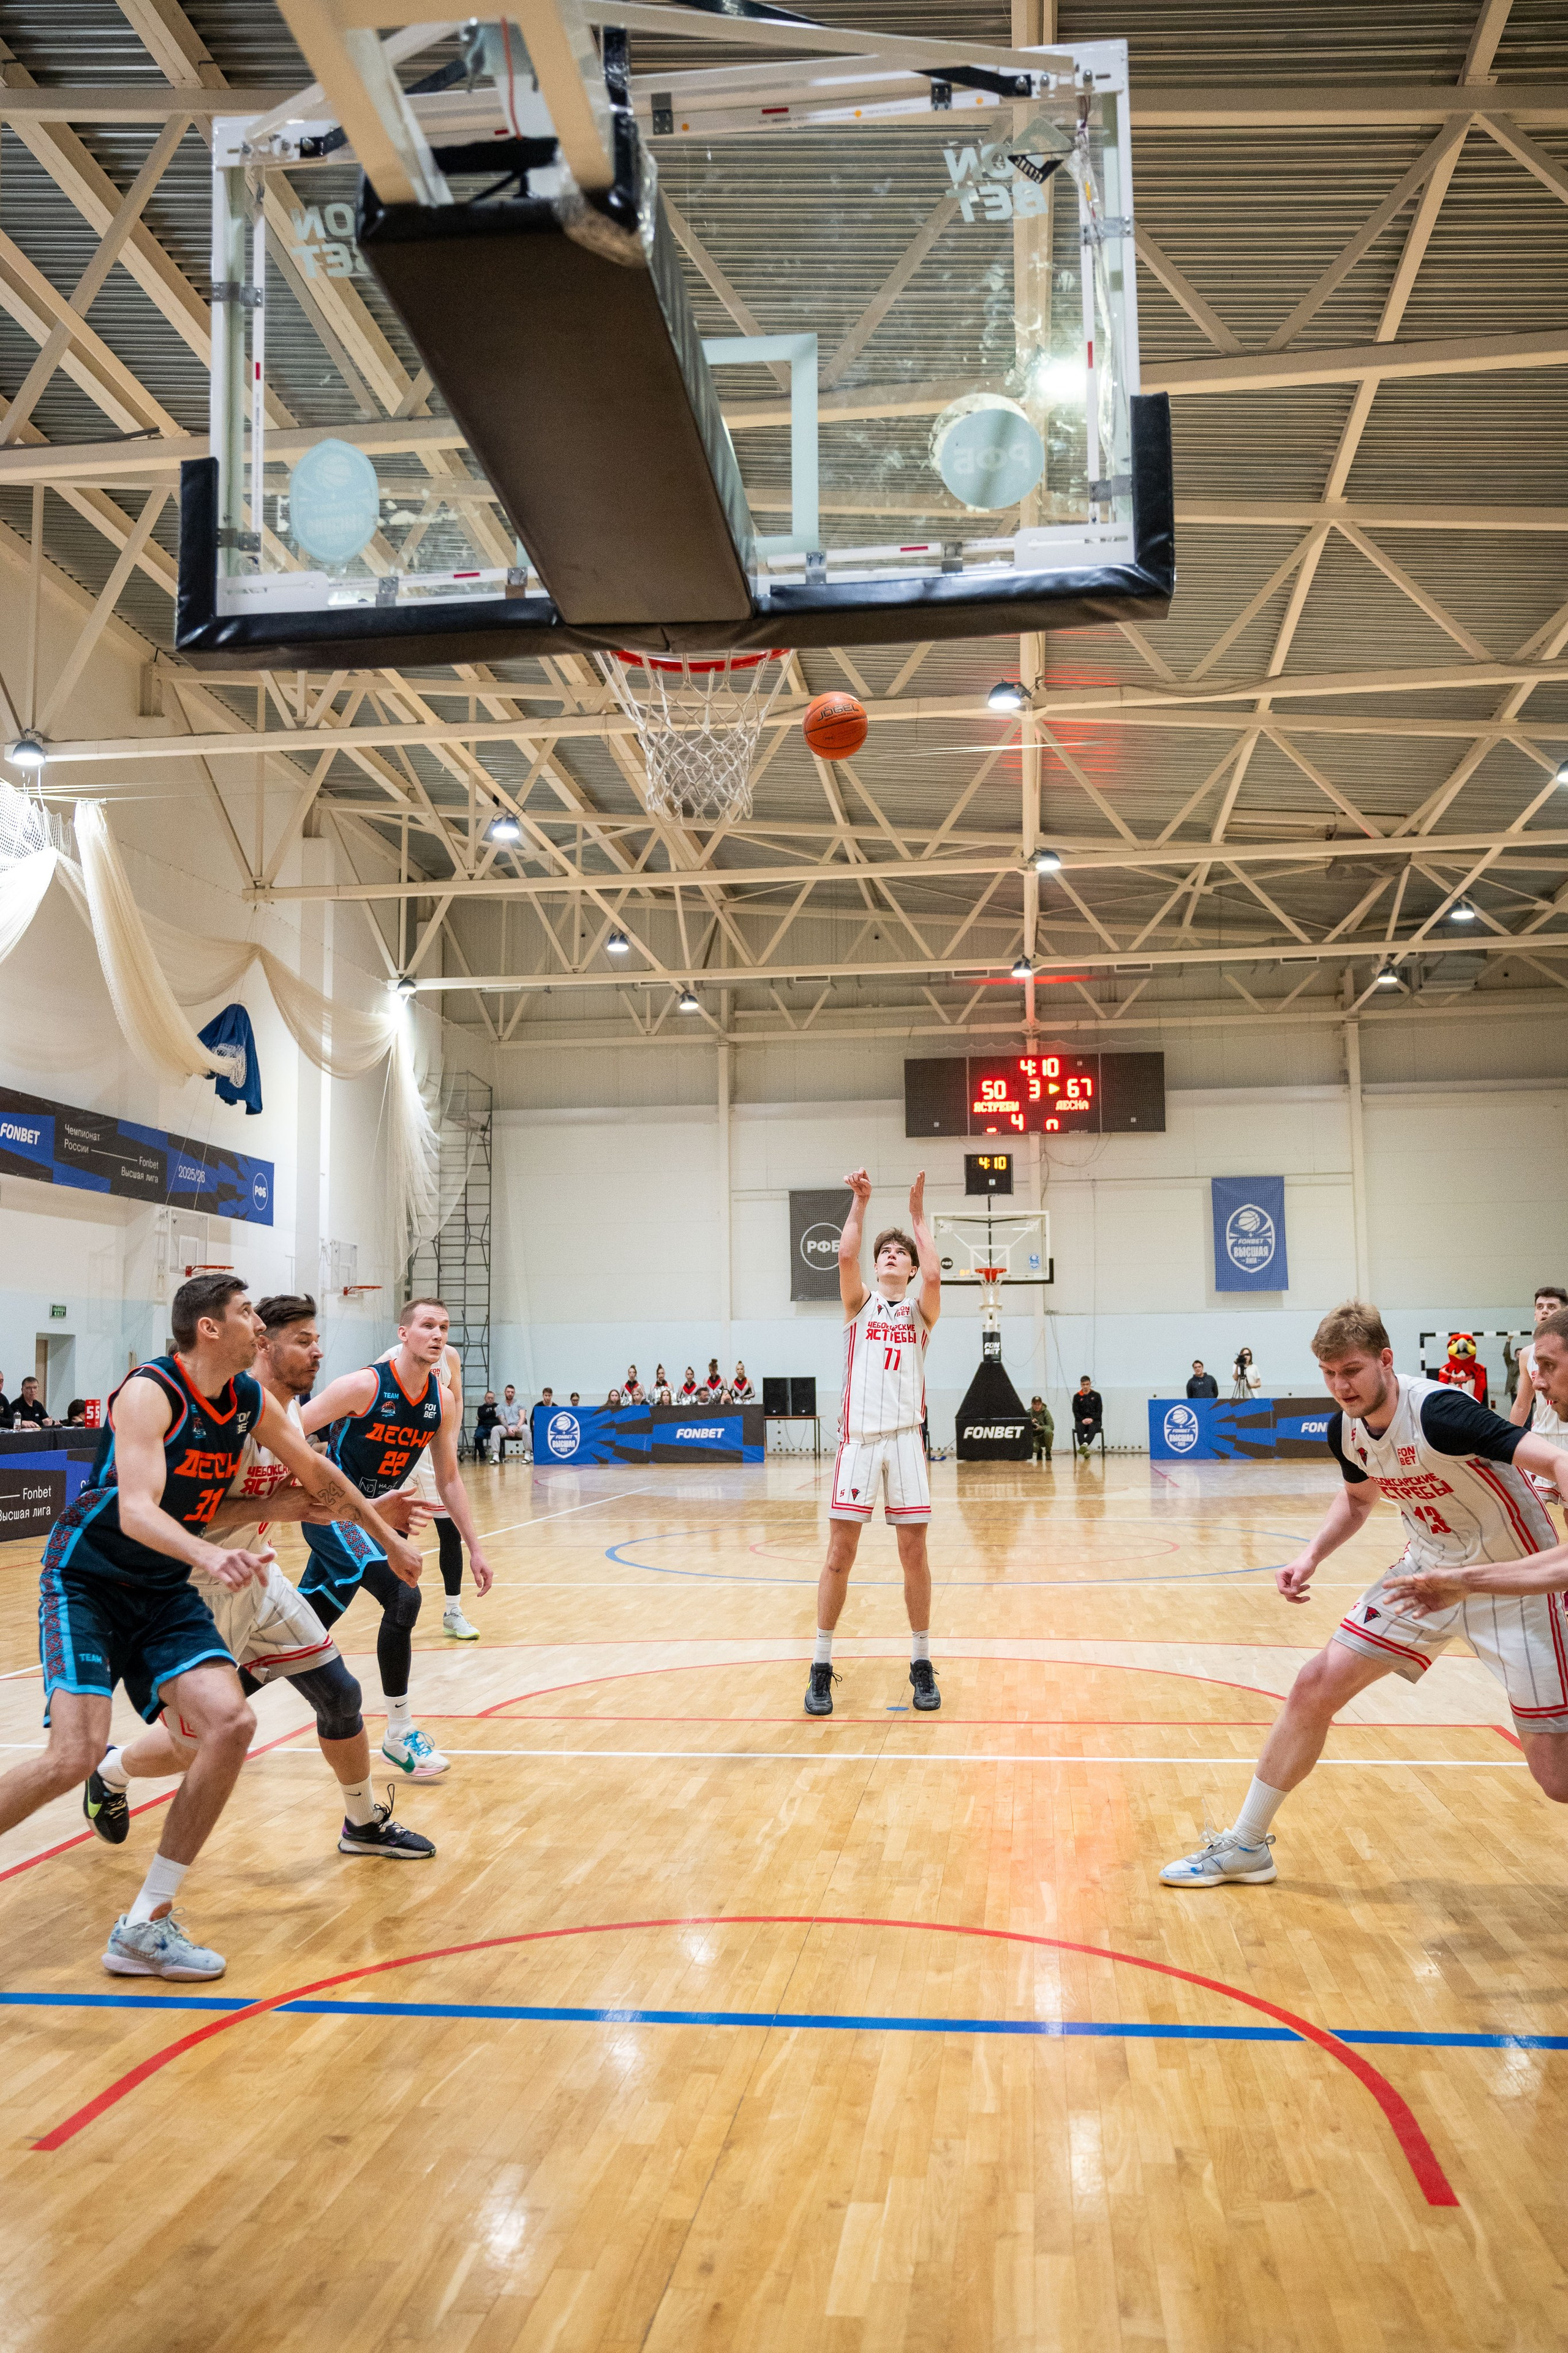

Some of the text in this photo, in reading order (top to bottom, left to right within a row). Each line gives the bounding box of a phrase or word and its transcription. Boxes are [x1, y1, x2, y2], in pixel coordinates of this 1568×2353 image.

[1020, 1058, 1059, 1077] 4:10
[982, 1081, 1006, 1100] 50
[1029, 1079, 1041, 1099] 3
[1067, 1078, 1091, 1098] 67
[973, 1101, 1019, 1112] ЯСТРЕБЫ
[1055, 1100, 1089, 1111] ДЕСНА
[1011, 1114, 1023, 1130] 4
[0, 1123, 40, 1145] FONBET
[65, 1124, 100, 1141] Чемпионат
[64, 1139, 89, 1154] России
[139, 1156, 159, 1169] Fonbet
[978, 1156, 1006, 1170] 4:10
[121, 1166, 159, 1183] Высшая лига
[178, 1165, 206, 1183] 2025/26
[255, 1185, 266, 1198] РФБ
[807, 1240, 840, 1253] РФБ
[676, 1428, 725, 1439] FONBET
[963, 1426, 1025, 1439] FONBET
[1301, 1422, 1329, 1433] FON
[1397, 1445, 1415, 1457] FON
[377, 1451, 410, 1477] 22
[1400, 1456, 1416, 1465] BET
[23, 1486, 51, 1500] Fonbet
[1380, 1479, 1454, 1500] СТРЕБЫ
[32, 1506, 51, 1517] лига
[183, 1488, 225, 1523] 31
[1414, 1506, 1452, 1535] 13
[79, 1653, 102, 1664] TEAM
